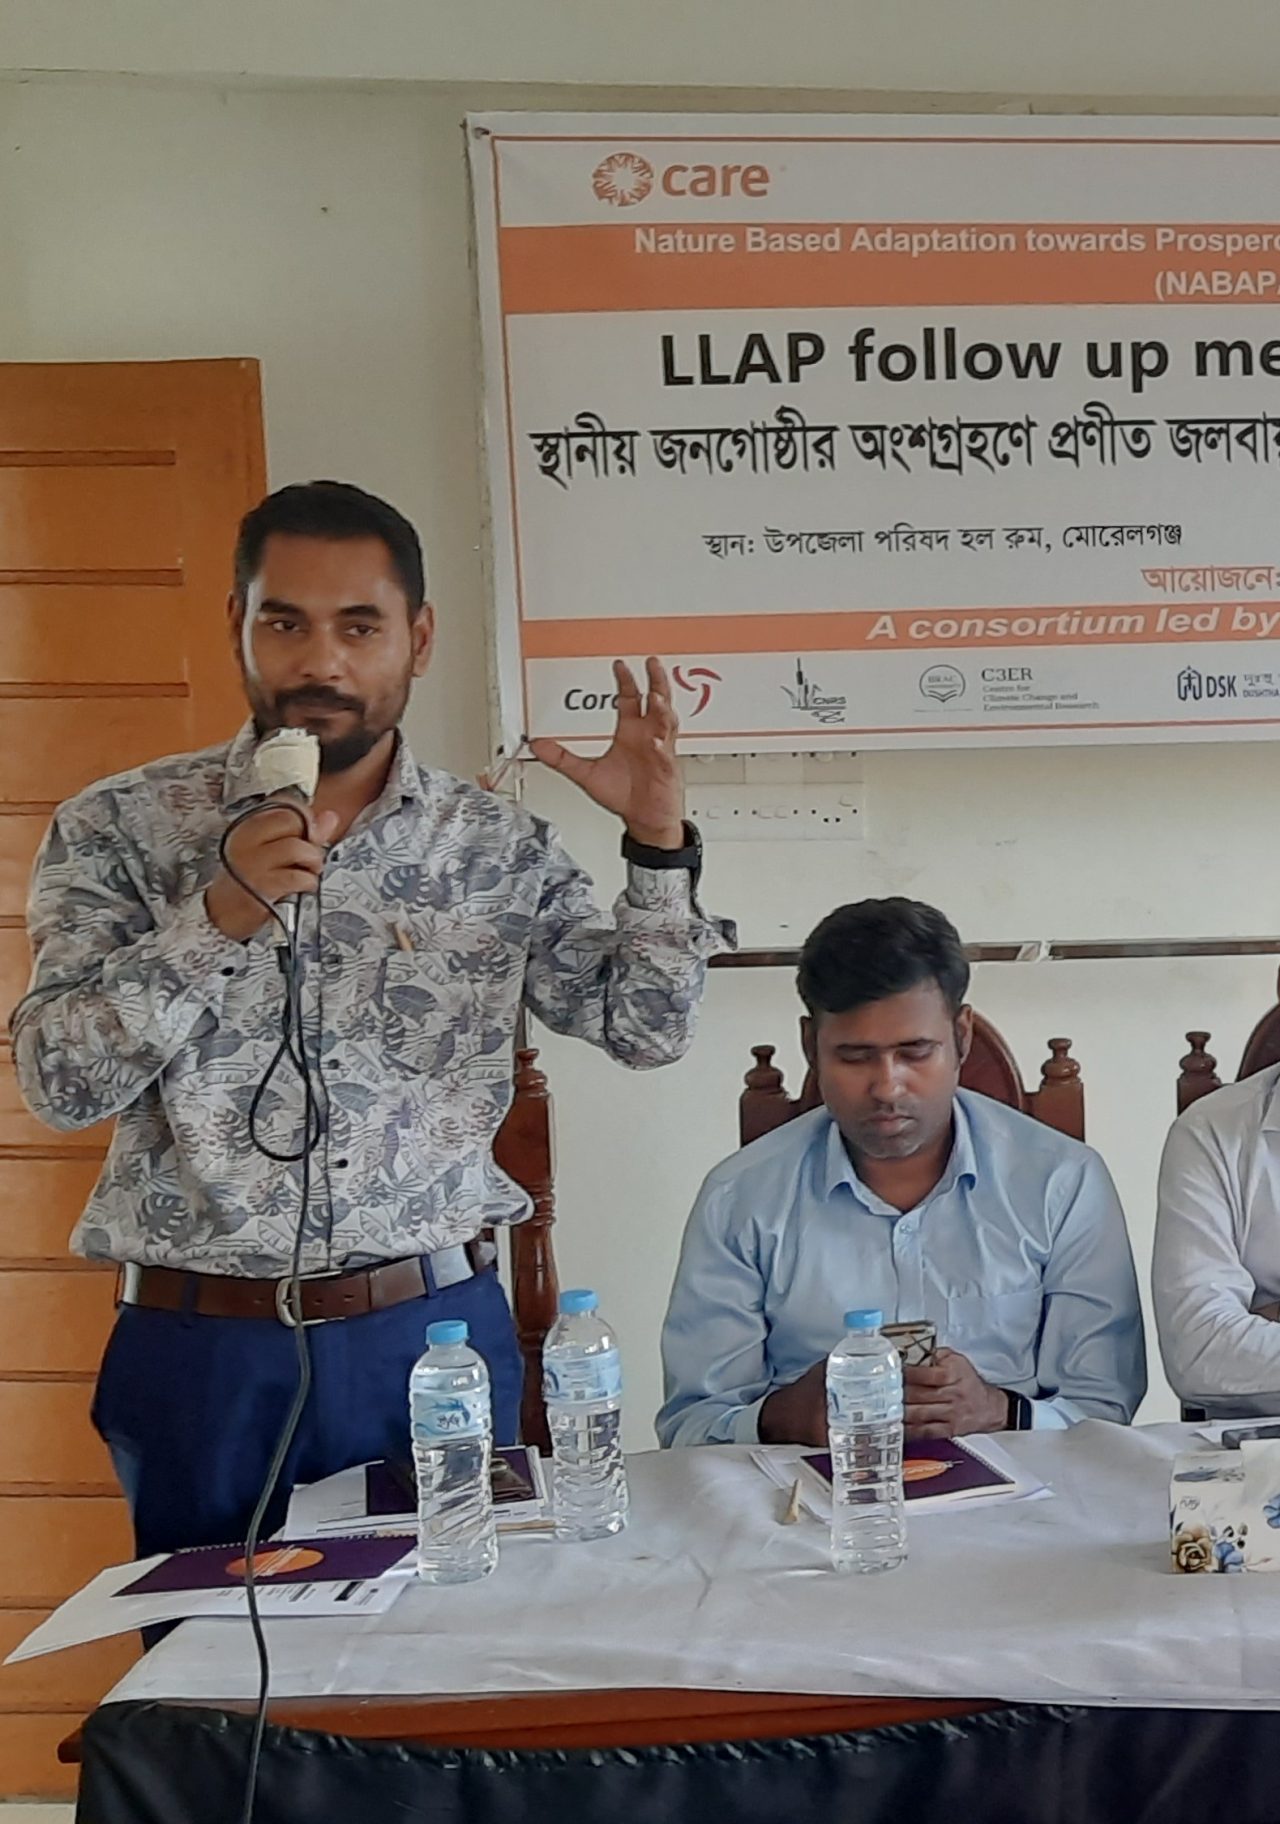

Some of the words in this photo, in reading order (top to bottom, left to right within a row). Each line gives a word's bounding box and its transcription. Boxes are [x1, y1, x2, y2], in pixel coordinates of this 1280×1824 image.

[661, 164, 770, 198] care
[635, 227, 736, 254] Nature
[746, 227, 841, 252] Based
[850, 227, 1016, 258] Adaptation
[1025, 227, 1146, 252] towards
[661, 332, 825, 386] LLAP
[848, 326, 1062, 382] follow
[1086, 340, 1169, 394] up
[528, 411, 641, 488] স্থানীয়
[648, 405, 840, 474] জনগোষ্ঠীর
[848, 415, 1039, 475] অংশগ্রহণে
[1048, 400, 1157, 468] প্রণীত
[763, 527, 865, 555] উপজেলা
[874, 521, 950, 552] পরিষদ
[957, 528, 995, 551] হল
[1002, 527, 1052, 553] রুম,
[1062, 523, 1182, 548] মোরেলগঞ্জ
[865, 615, 897, 640] A
[908, 609, 1145, 640] consortium
[1155, 606, 1220, 633] led
[980, 667, 1033, 682] C3ER
[1205, 675, 1237, 699] DSK
